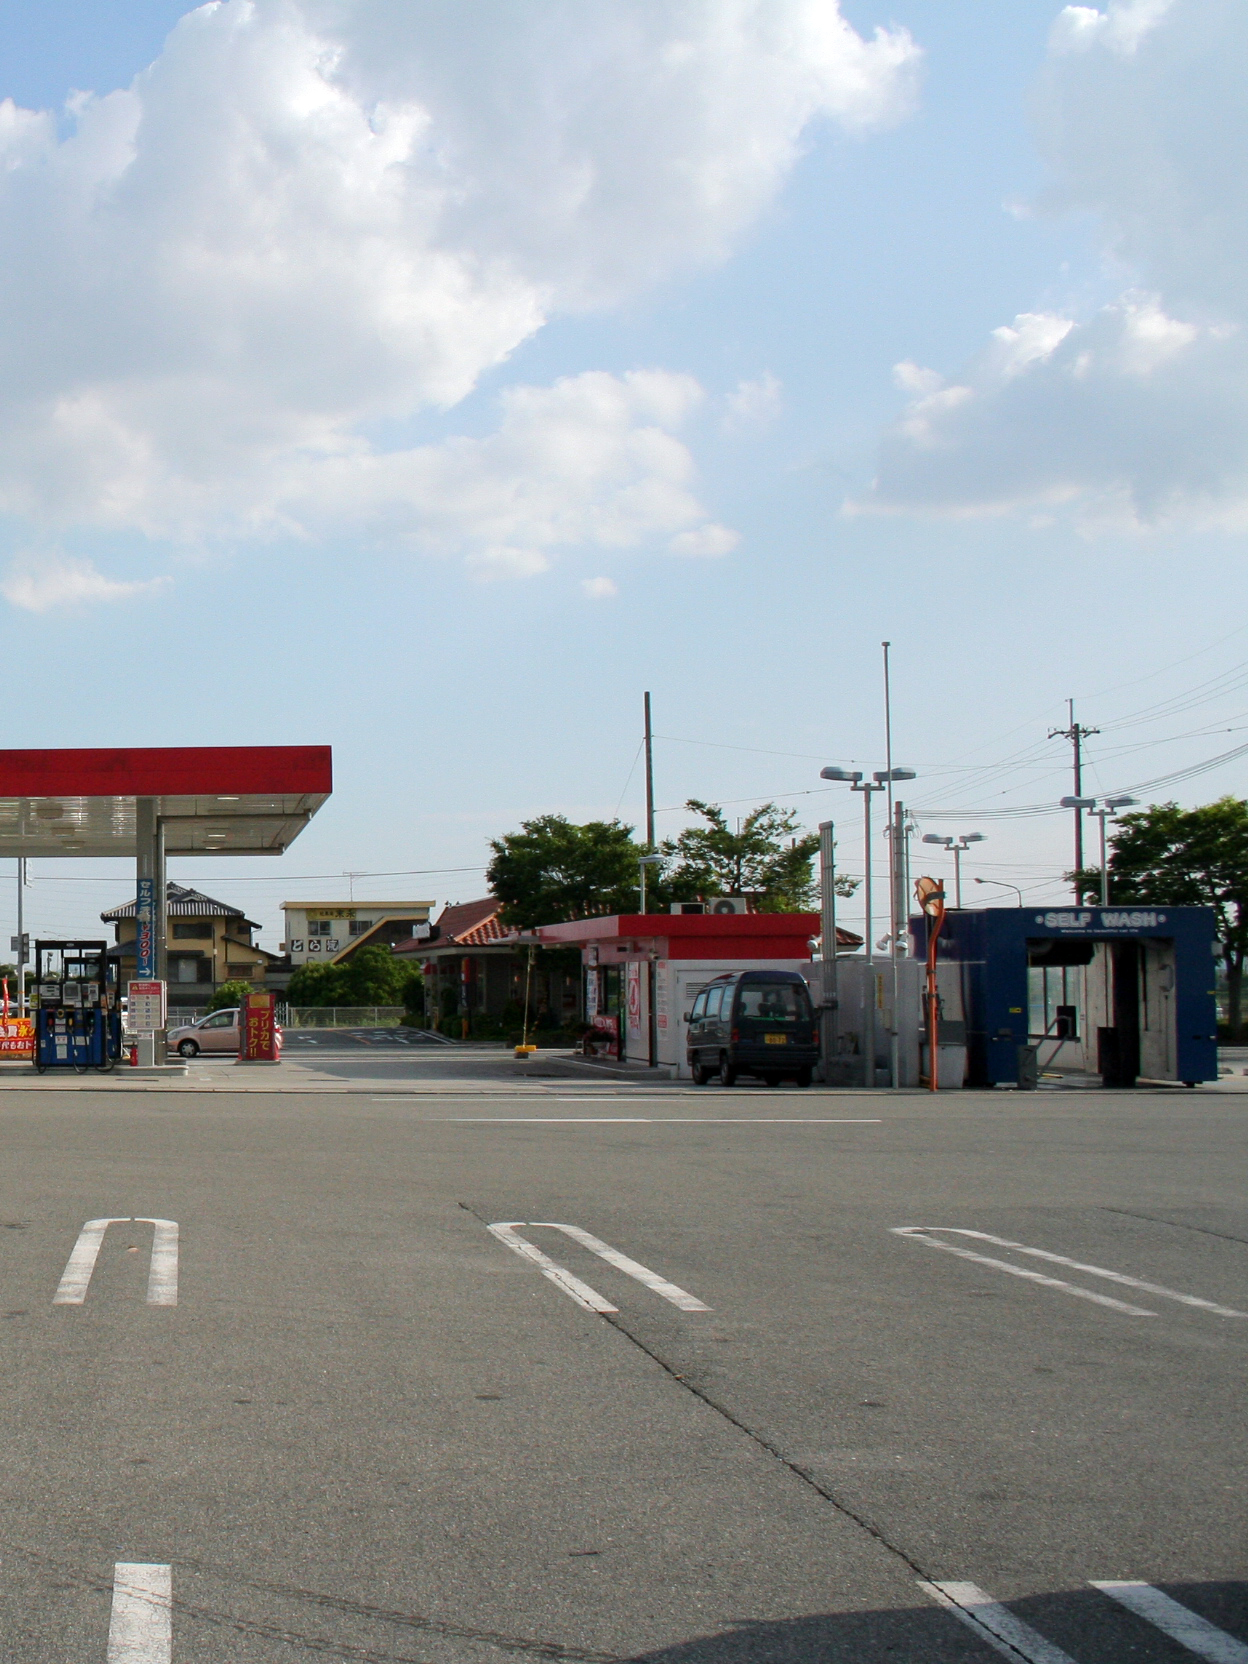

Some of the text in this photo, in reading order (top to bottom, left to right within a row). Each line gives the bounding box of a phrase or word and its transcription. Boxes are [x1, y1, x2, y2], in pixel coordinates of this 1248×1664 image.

[1044, 911, 1158, 928] SELF WASH
[260, 1010, 271, 1051] プリカで
